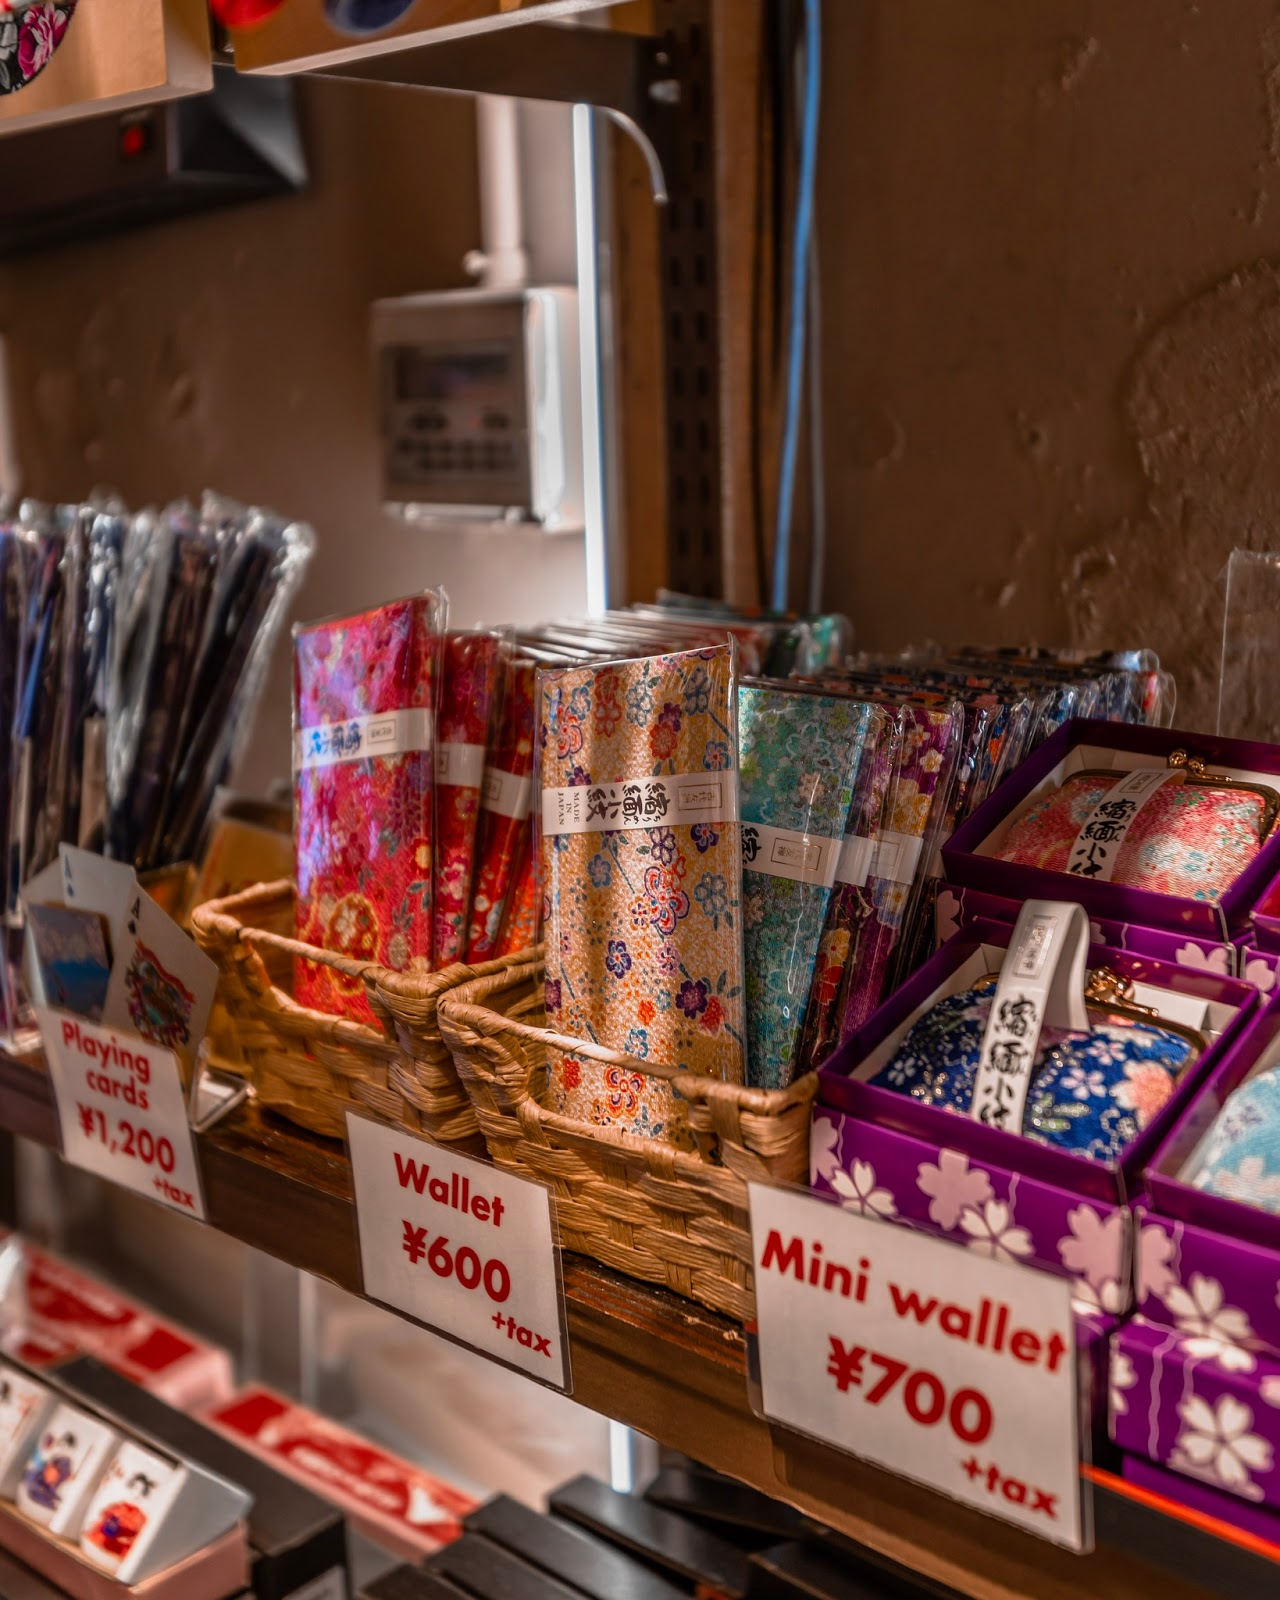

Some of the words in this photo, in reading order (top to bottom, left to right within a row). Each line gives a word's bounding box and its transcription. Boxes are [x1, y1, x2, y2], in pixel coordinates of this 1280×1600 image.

[557, 791, 565, 826] JAPAN
[565, 802, 572, 814] IN
[586, 782, 671, 823] 縮緬小紋
[131, 896, 140, 920] A
[60, 1018, 151, 1085] Playing
[85, 1070, 150, 1110] cards
[76, 1101, 175, 1173] ¥1,200
[153, 1176, 196, 1210] +tax
[393, 1152, 505, 1227] Wallet
[402, 1219, 511, 1303] ¥600
[760, 1228, 871, 1304] Mini
[888, 1281, 1067, 1373] wallet
[491, 1312, 552, 1358] +tax
[826, 1333, 994, 1446] ¥700
[960, 1456, 1061, 1520] +tax
